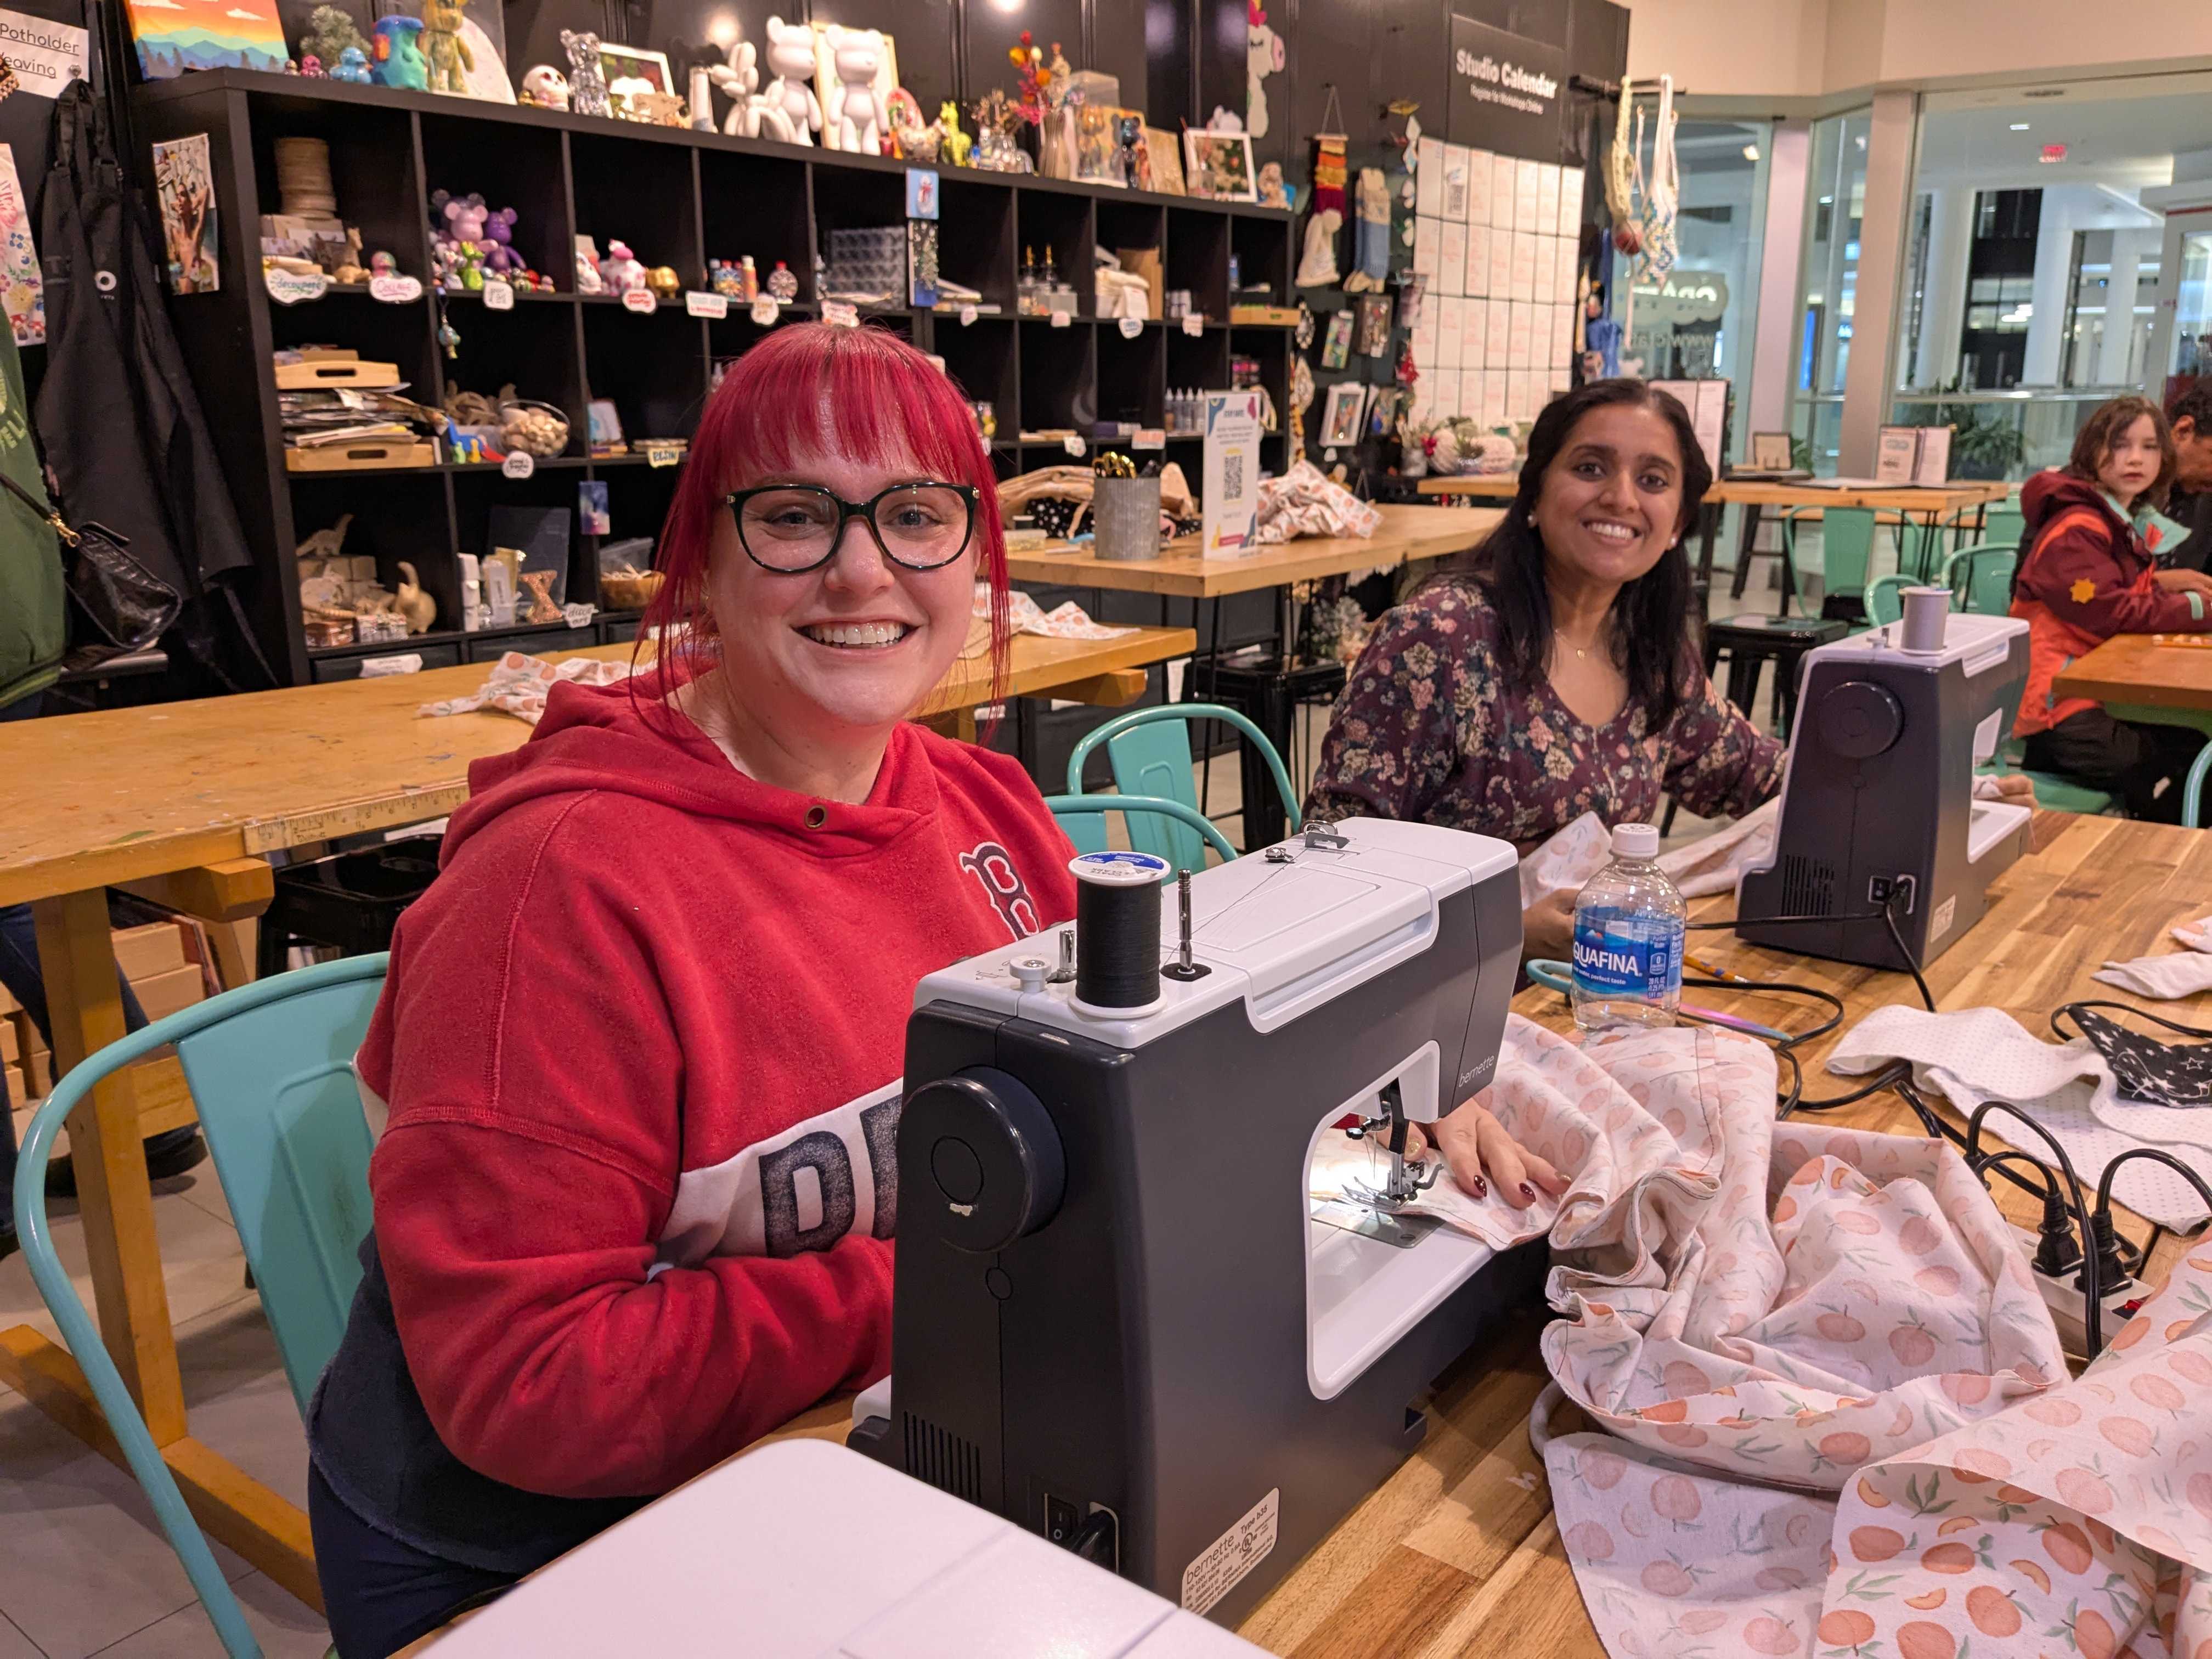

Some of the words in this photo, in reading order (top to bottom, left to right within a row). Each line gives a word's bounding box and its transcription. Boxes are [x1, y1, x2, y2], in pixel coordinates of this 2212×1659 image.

[0, 22, 79, 53] Potholder
[2, 53, 56, 78] eaving
[1457, 48, 1499, 83] Studio
[1501, 62, 1558, 99] Calendar
[959, 842, 1041, 941] B
[1573, 941, 1639, 977] QUAFINA
[1590, 973, 1610, 983] perfect
[1611, 978, 1627, 986] taste
[1459, 1054, 1495, 1088] bernette
[1187, 1535, 1234, 1585] bernette
[1241, 1517, 1256, 1534] Type
[1256, 1504, 1268, 1520] b35
